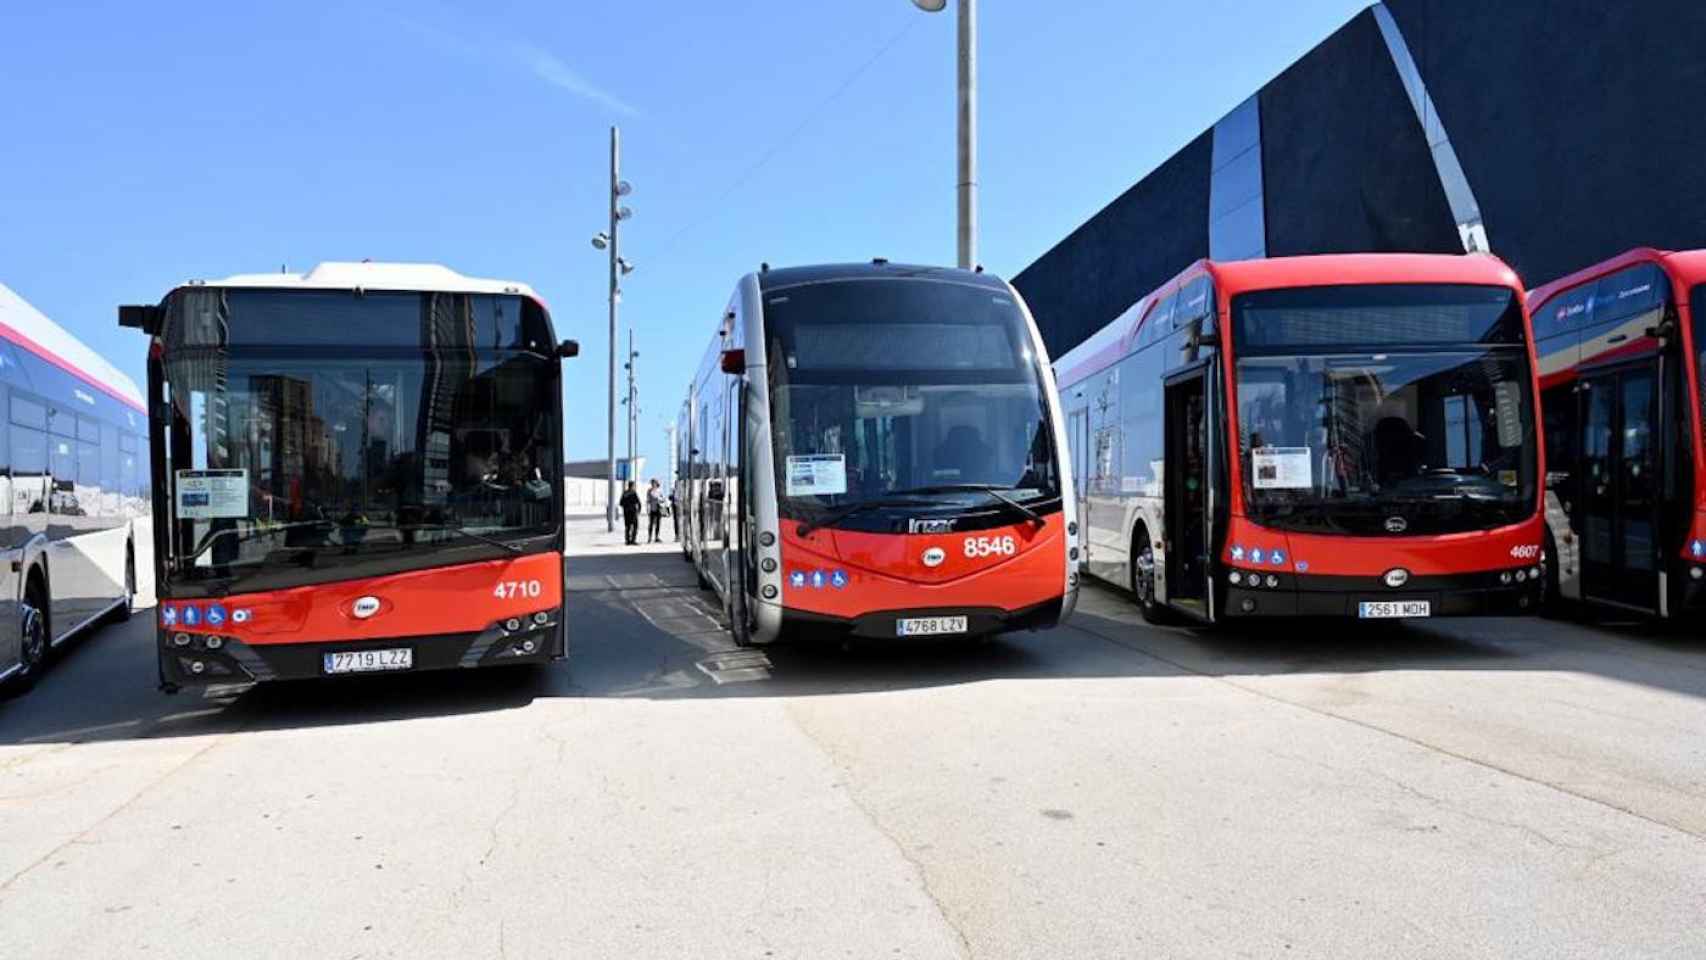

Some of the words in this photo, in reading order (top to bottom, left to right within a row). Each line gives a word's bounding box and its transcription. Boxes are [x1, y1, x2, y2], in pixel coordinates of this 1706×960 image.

[963, 535, 1016, 558] 8546
[1510, 544, 1540, 559] 4607
[493, 579, 542, 599] 4710
[1367, 602, 1398, 617] 2561
[906, 620, 938, 634] 4768
[336, 652, 375, 669] 7719
[379, 649, 408, 666] LZZ
